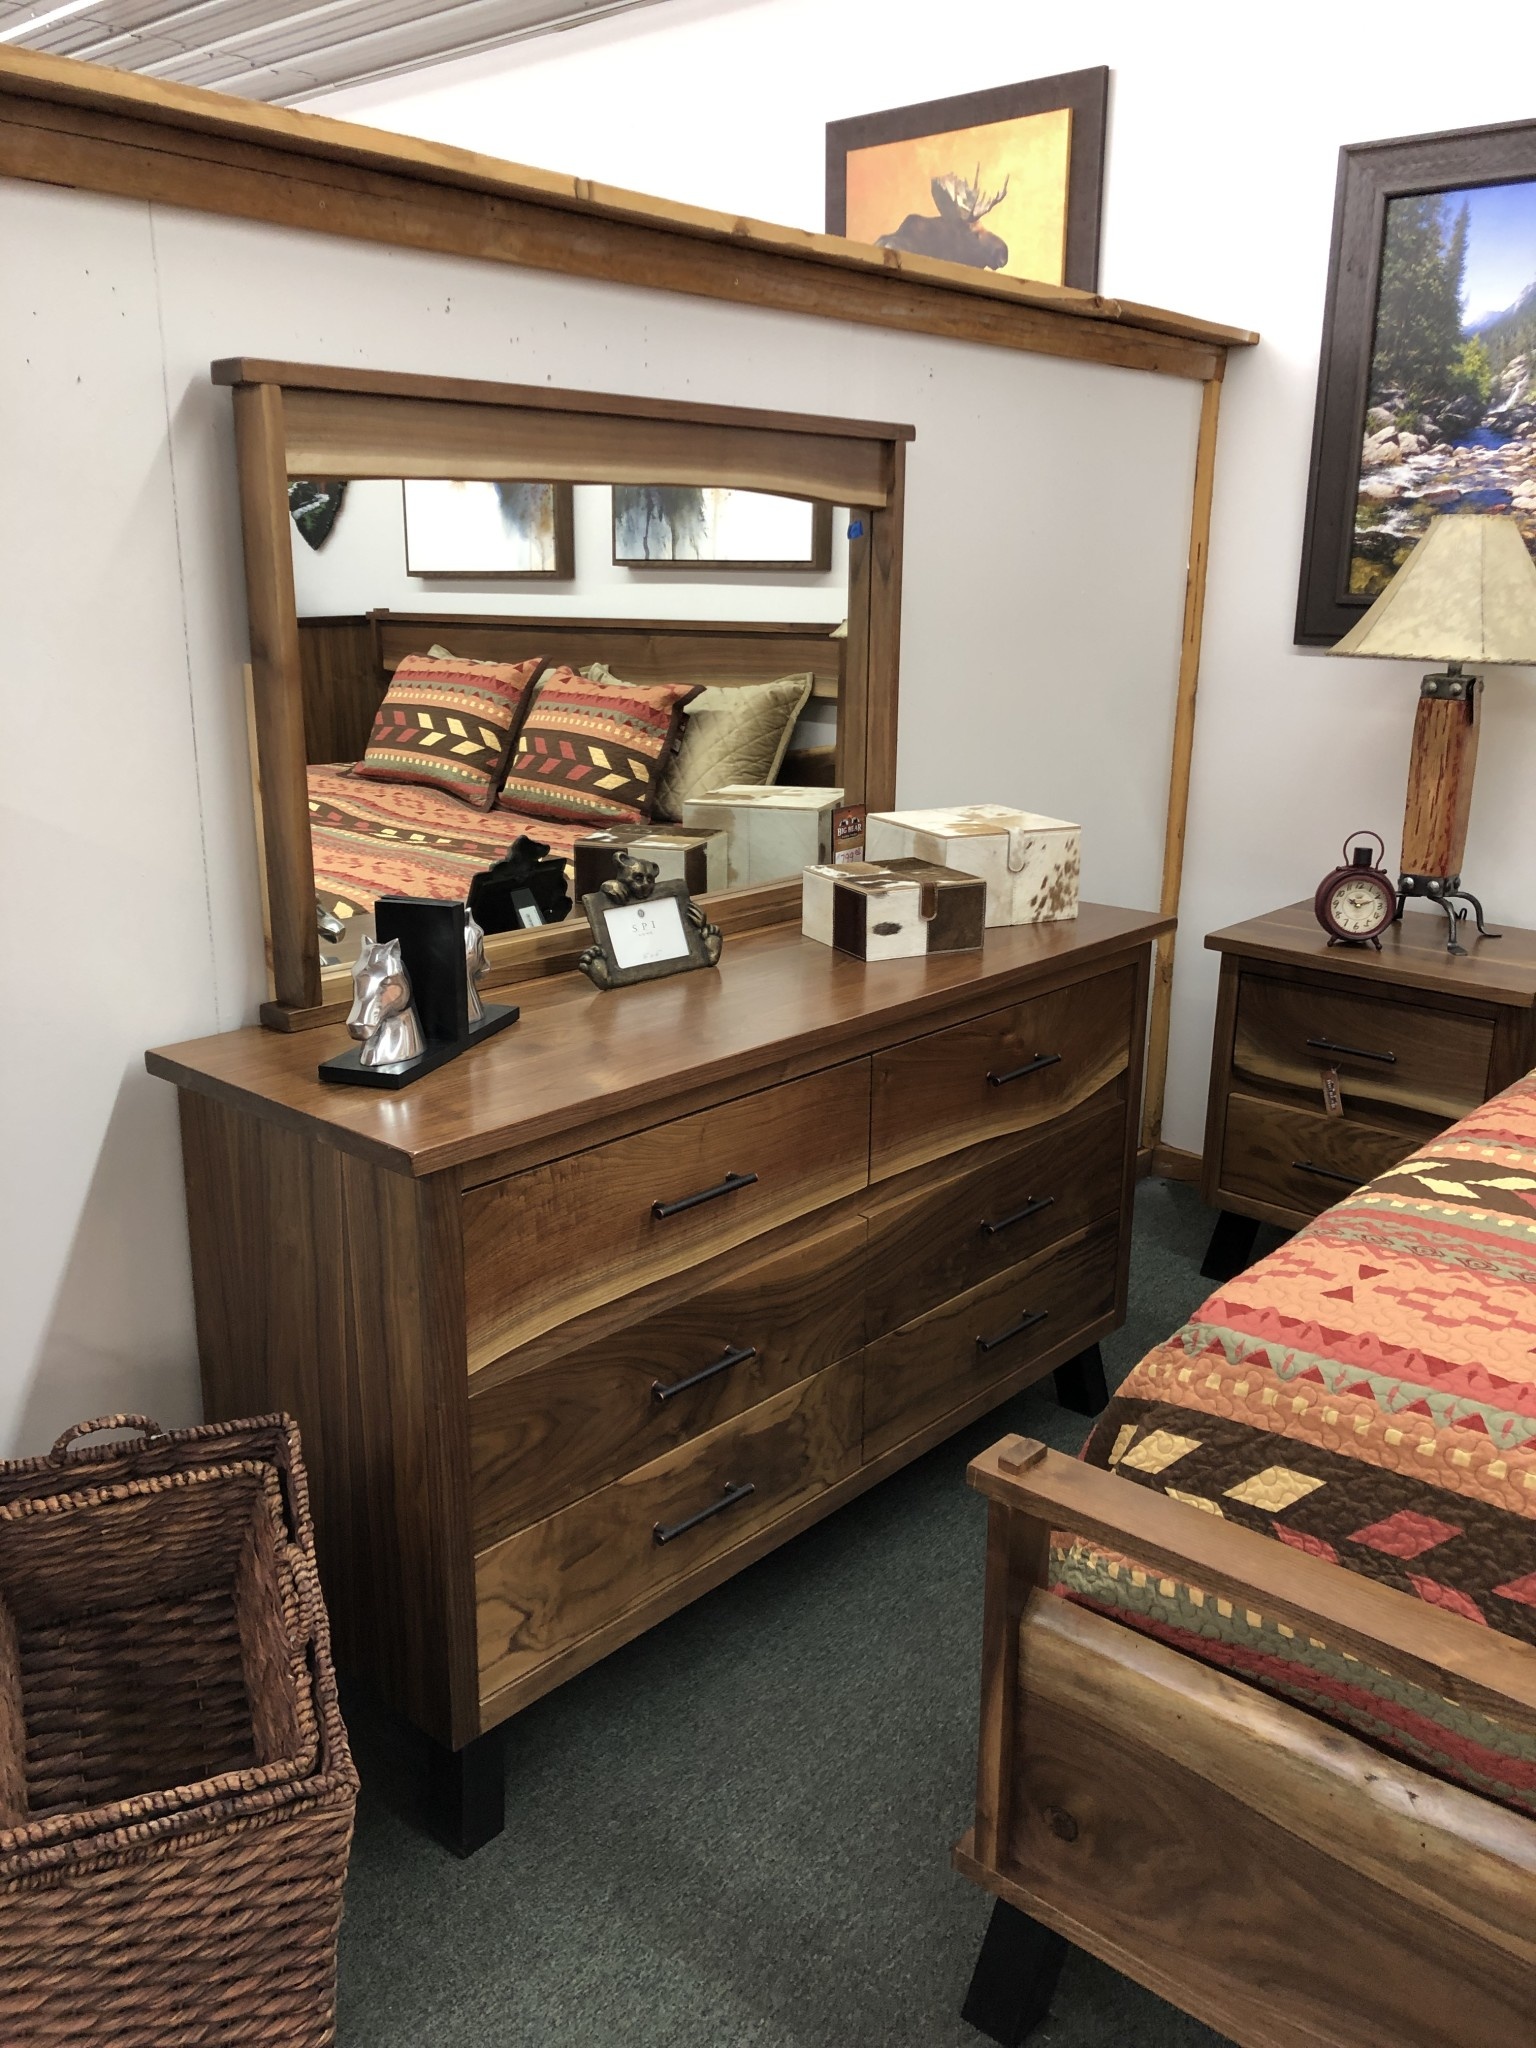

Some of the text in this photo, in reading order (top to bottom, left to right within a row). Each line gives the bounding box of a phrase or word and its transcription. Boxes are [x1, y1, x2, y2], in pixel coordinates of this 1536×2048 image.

[837, 827, 847, 836] BIG
[848, 824, 862, 832] BEAR
[1333, 900, 1339, 909] 9
[1335, 911, 1342, 919] 8
[1344, 919, 1349, 927] 7
[1353, 922, 1359, 930] 6
